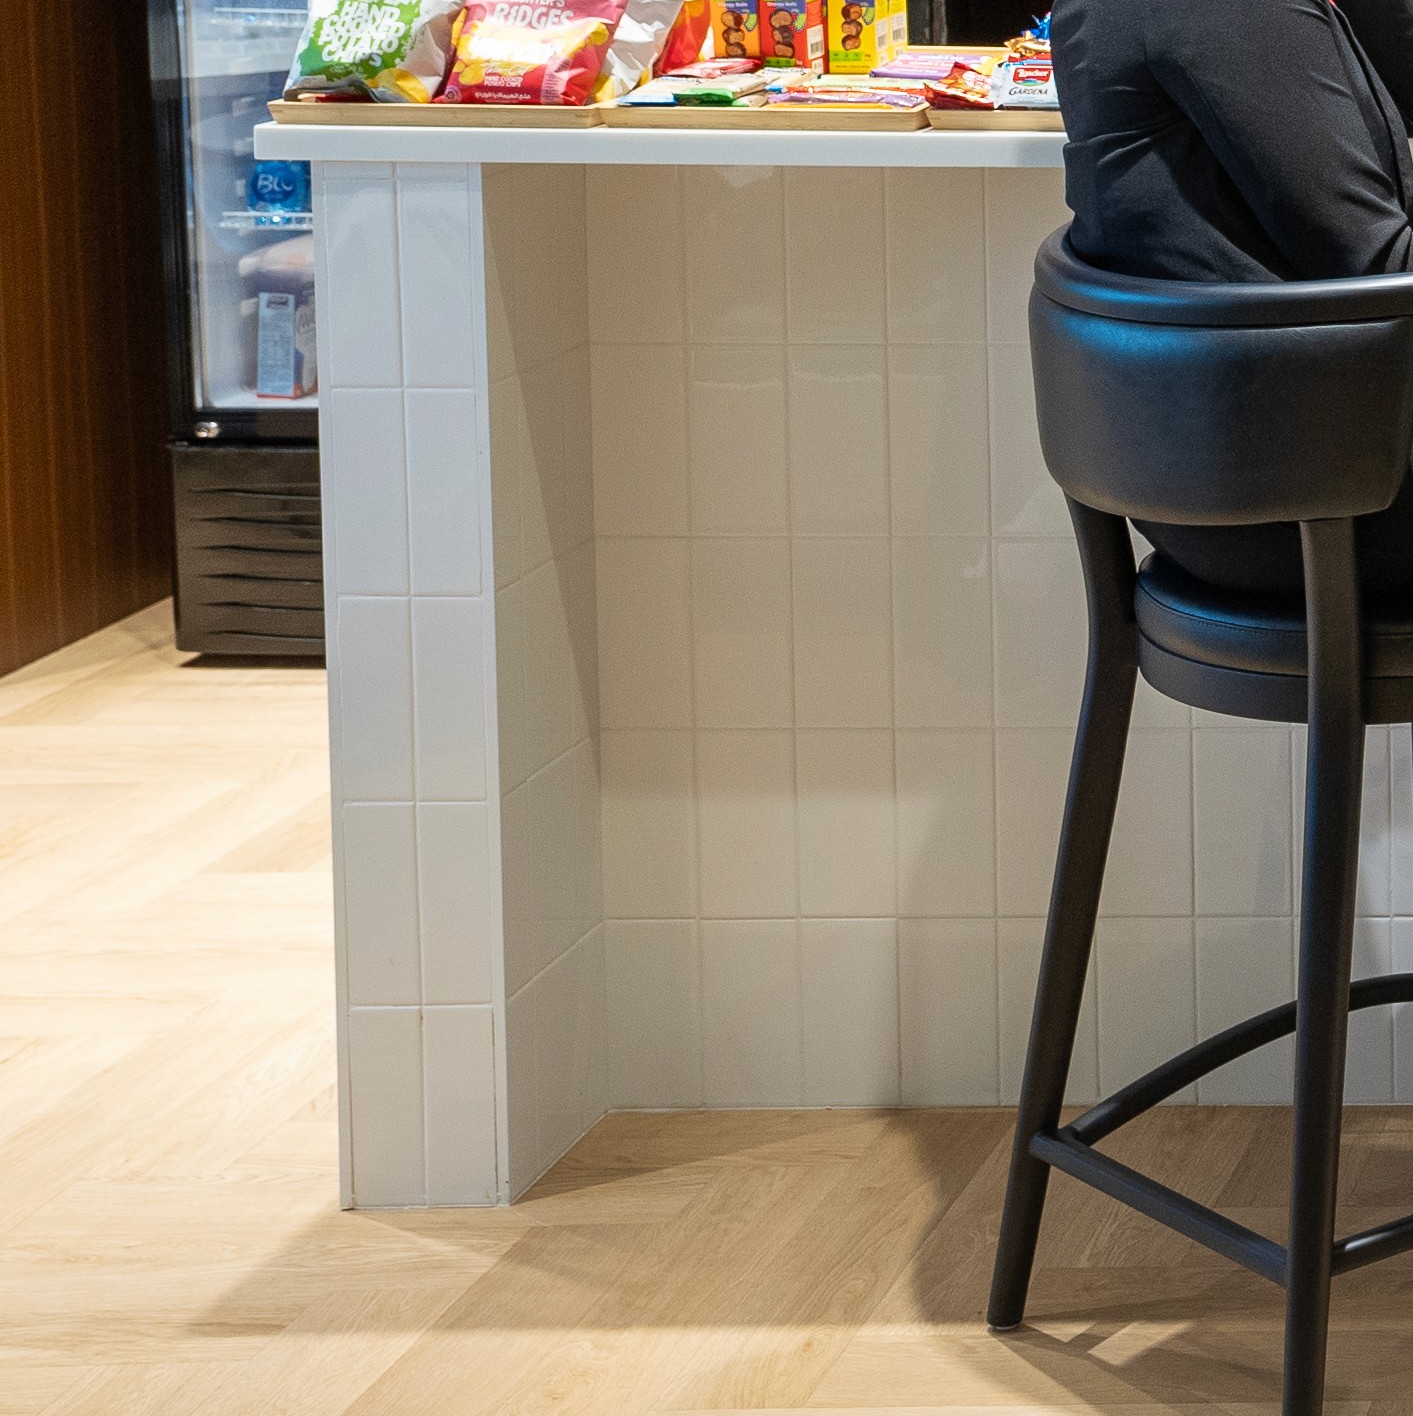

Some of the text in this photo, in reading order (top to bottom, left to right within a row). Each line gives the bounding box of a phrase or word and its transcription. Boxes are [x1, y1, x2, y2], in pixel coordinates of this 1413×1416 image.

[340, 0, 401, 25] HAND
[494, 3, 574, 29] RIDGES
[322, 14, 406, 39] COOKED
[318, 29, 399, 54] POTATO
